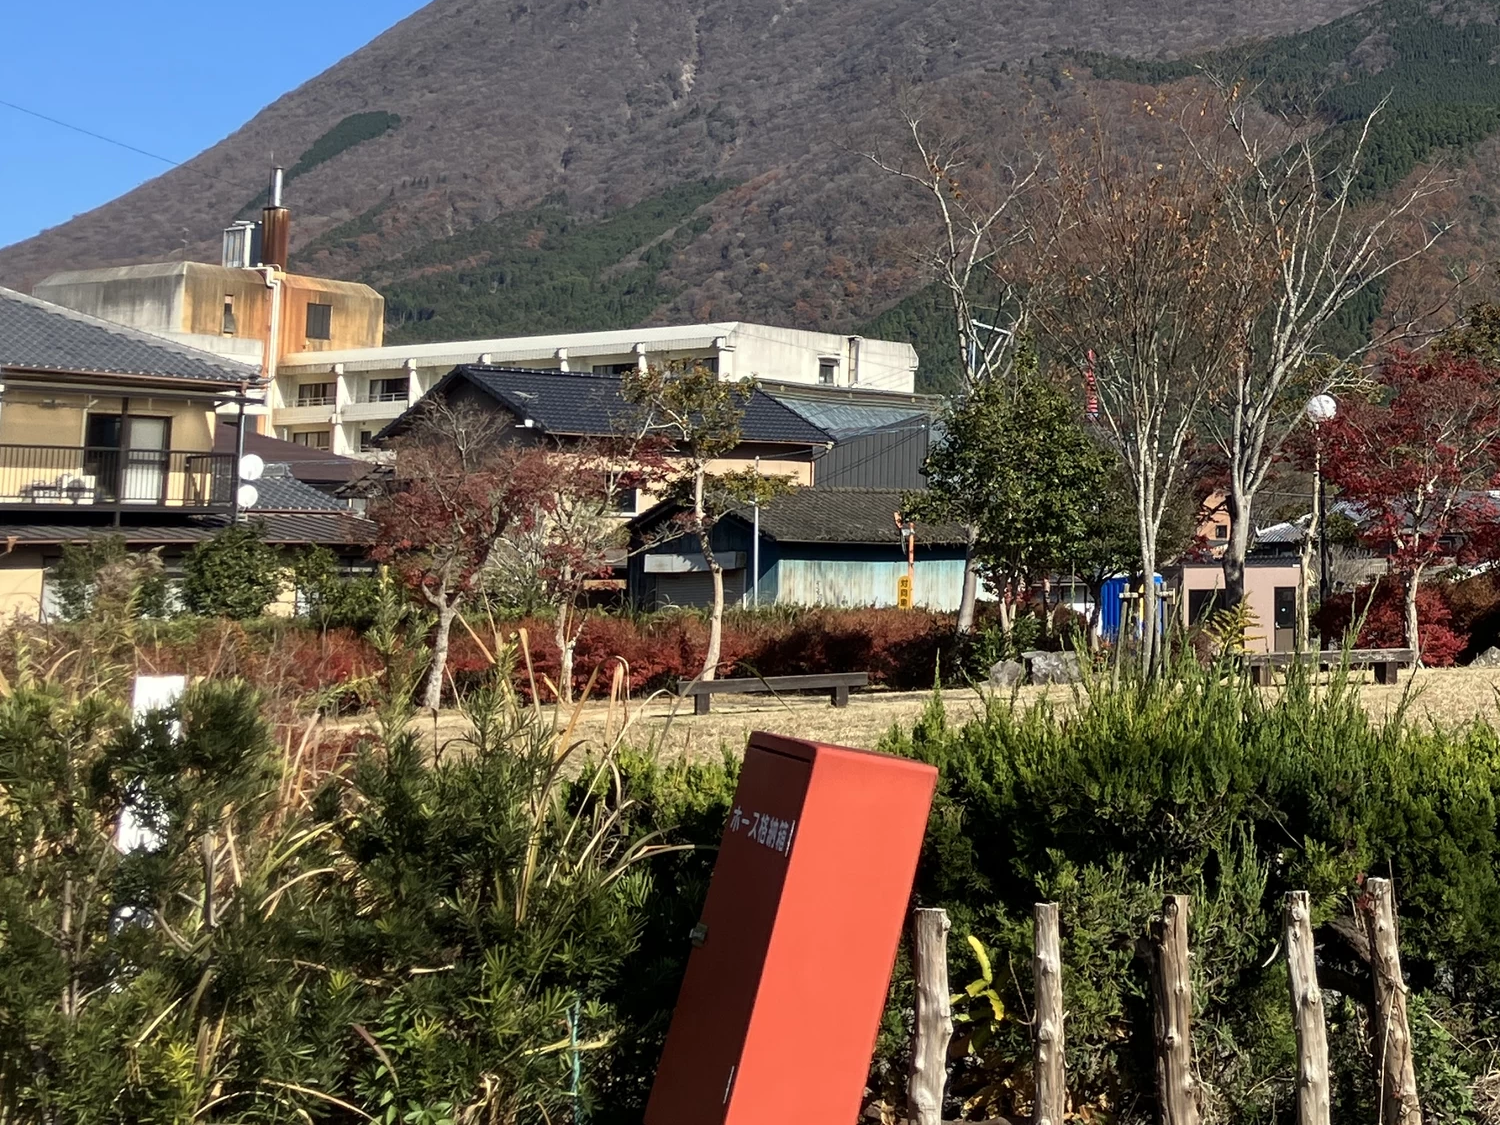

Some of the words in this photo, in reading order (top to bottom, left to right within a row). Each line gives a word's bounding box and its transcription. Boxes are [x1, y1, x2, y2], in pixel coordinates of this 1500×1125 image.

[729, 805, 789, 852] ホース格納箱
